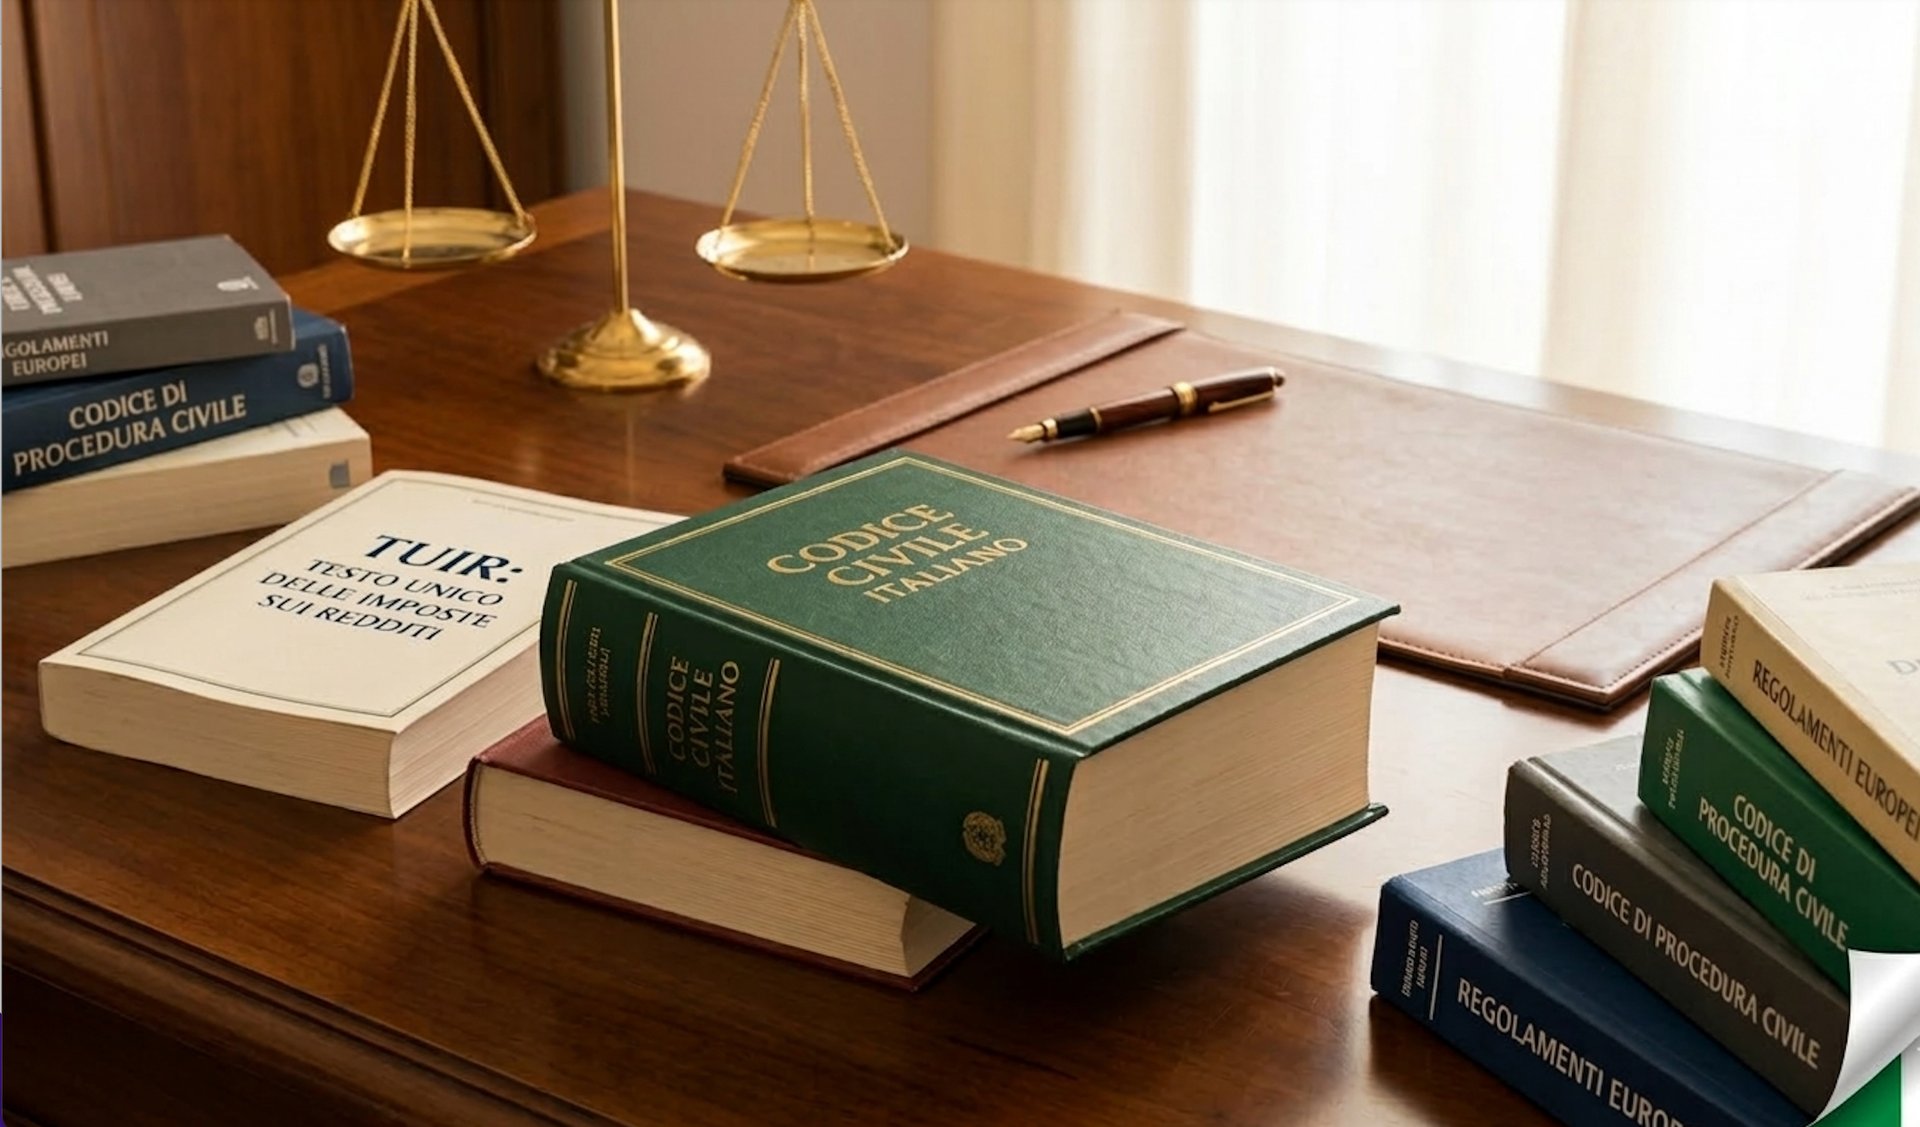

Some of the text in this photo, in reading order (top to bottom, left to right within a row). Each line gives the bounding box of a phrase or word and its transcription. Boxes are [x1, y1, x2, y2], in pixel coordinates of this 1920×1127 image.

[2, 330, 109, 359] GOLAMENTI
[12, 352, 88, 377] EUROPEI
[12, 394, 248, 477] PROCEDURA CIVILE
[68, 379, 188, 431] CODICE DI
[364, 534, 524, 584] TUIR:
[767, 502, 955, 576] CODICE
[826, 522, 989, 588] CIVILE
[863, 536, 1029, 605] ITALIANO
[257, 594, 446, 642] SUI REDDITI
[258, 572, 499, 630] DELLE IMPOSTE
[306, 558, 504, 607] TESTO UNICO
[664, 655, 692, 763] CODICE
[690, 667, 716, 770] CIVILE
[714, 660, 741, 795] ITALIANO
[1752, 659, 1854, 777] REGOLAMENTI
[1854, 756, 1920, 842] EUROPEI
[1698, 796, 1850, 952] PROCEDURA CIVILE
[1733, 794, 1817, 883] CODICE DI
[1571, 863, 1822, 1070] CODICE DI PROCEDURA CIVILE
[1456, 976, 1605, 1097] REGOLAMENTI
